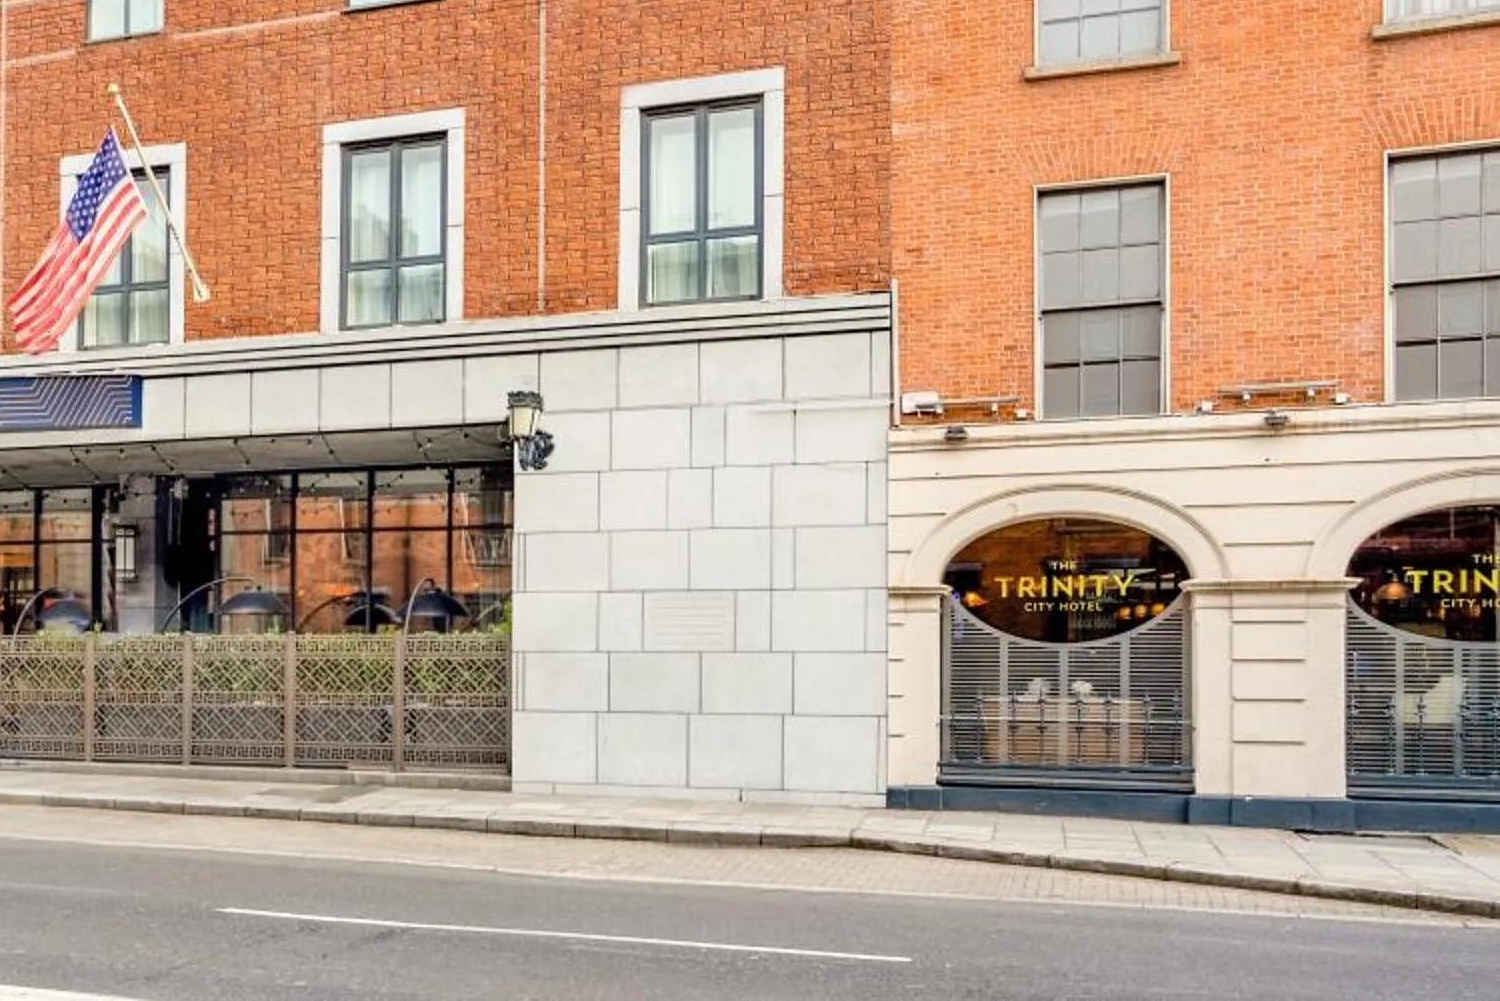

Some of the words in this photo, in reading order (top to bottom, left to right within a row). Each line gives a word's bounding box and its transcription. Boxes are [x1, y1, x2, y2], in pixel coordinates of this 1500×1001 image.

[1050, 560, 1077, 572] THE
[994, 574, 1135, 598] TRINITY
[1023, 602, 1054, 612] CITY
[1059, 601, 1104, 612] HOTEL
[1440, 598, 1476, 608] CITY
